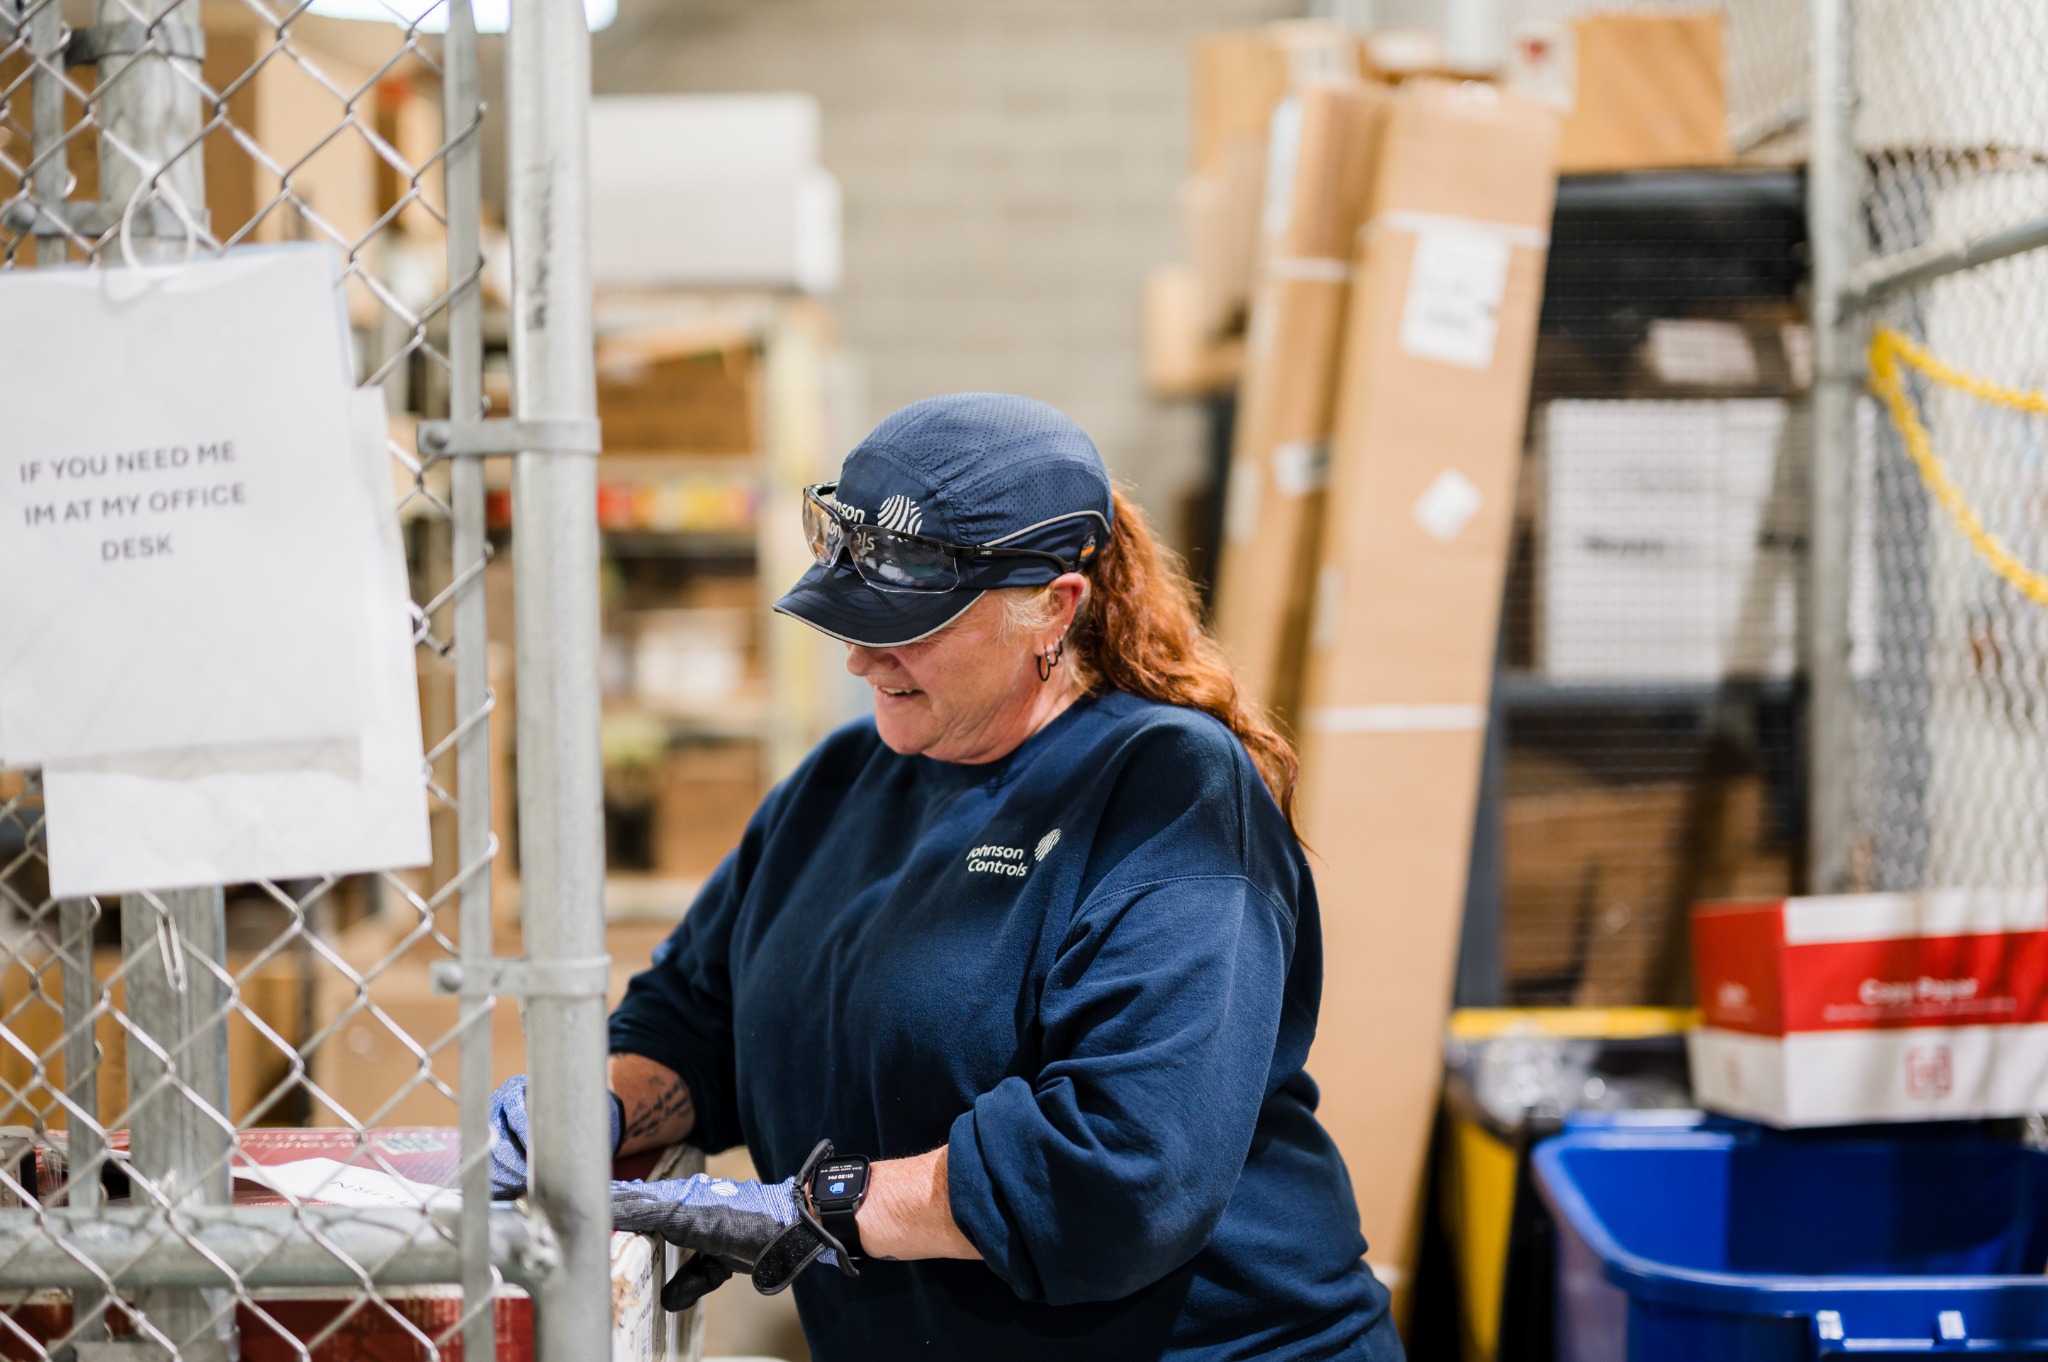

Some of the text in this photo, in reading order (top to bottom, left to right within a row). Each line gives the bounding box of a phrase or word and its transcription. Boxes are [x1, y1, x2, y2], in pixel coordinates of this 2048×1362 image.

[20, 440, 235, 483] IF YOU NEED ME
[25, 482, 245, 526] IM AT MY OFFICE
[102, 533, 173, 562] DESK
[966, 844, 1024, 861] Johnson
[968, 859, 1028, 876] Controls
